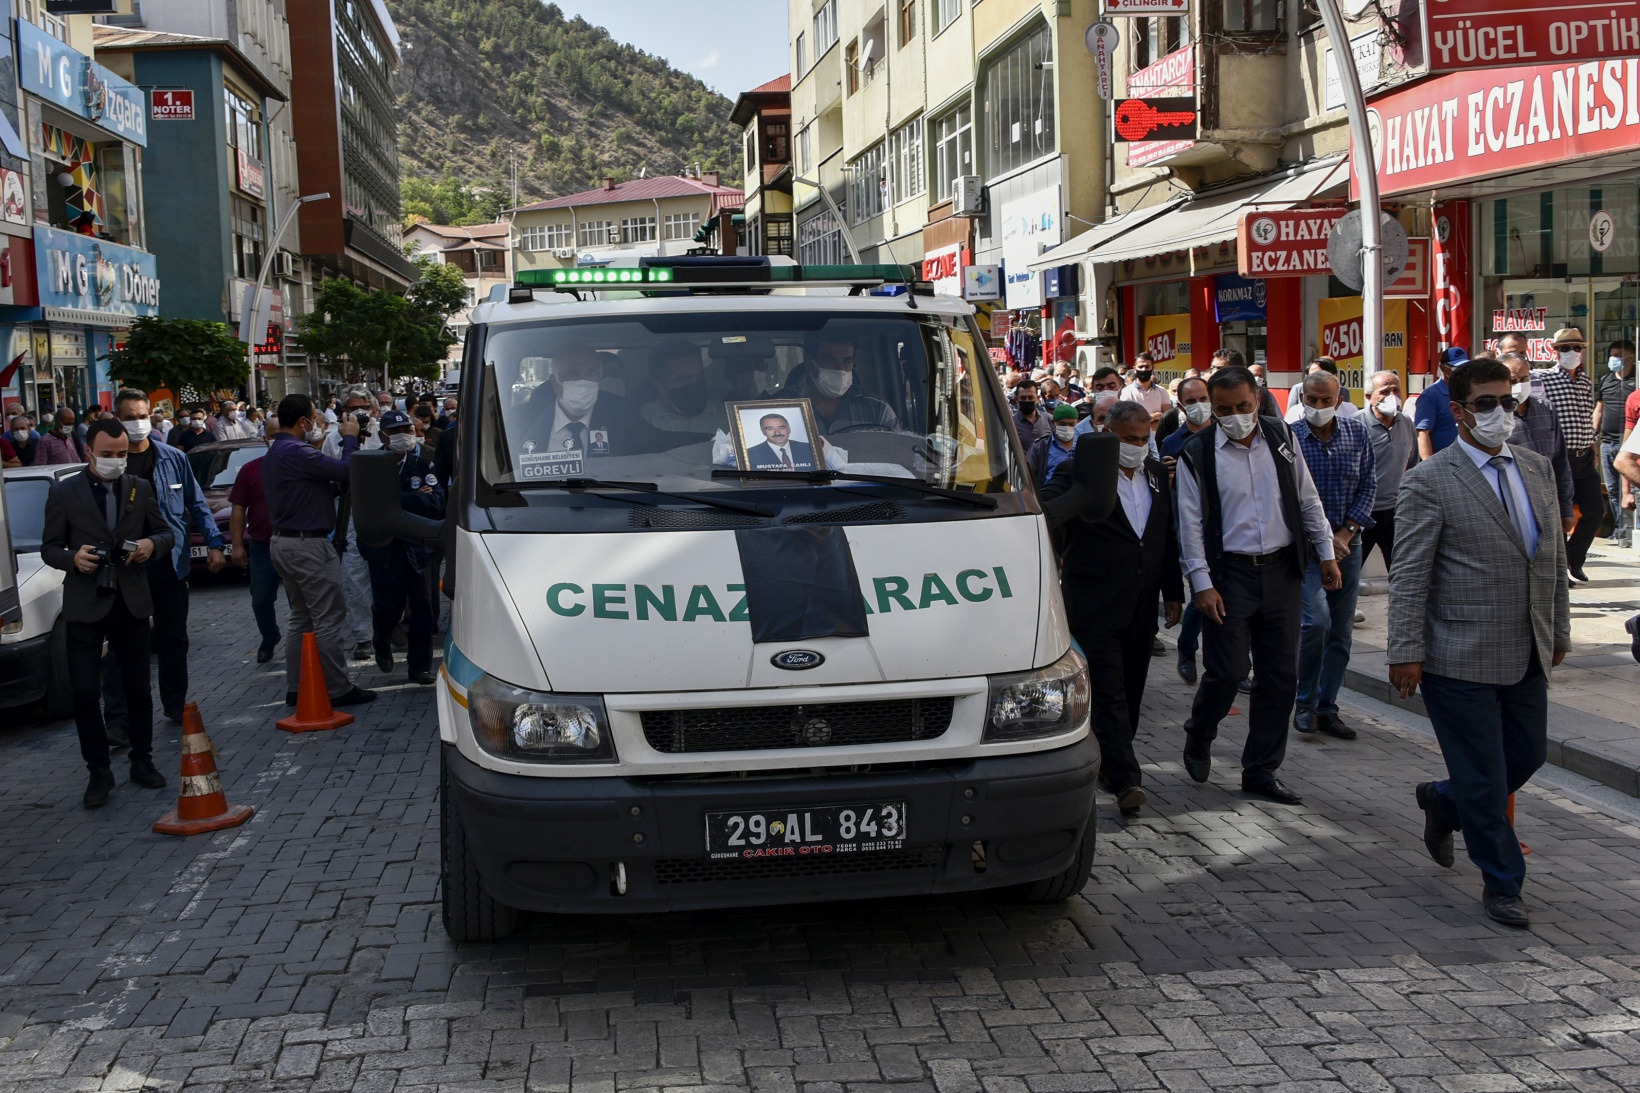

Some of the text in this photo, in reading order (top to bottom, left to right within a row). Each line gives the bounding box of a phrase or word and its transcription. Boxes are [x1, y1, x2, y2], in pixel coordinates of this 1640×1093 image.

[1434, 10, 1640, 63] YÜCEL OPTİK
[1096, 37, 1108, 97] ANAHTARCI
[153, 105, 192, 114] NOTER
[163, 92, 181, 105] 1.
[1386, 97, 1458, 176] HAYAT
[1251, 248, 1332, 272] ECZANE
[121, 261, 160, 306] Döner
[1218, 287, 1253, 303] KORKMAZ
[1493, 307, 1547, 332] HAYAT
[1384, 332, 1403, 348] RAN
[524, 461, 580, 477] GÖREVLİ
[544, 566, 1014, 622] CENAZ RACI
[787, 653, 809, 663] Ford
[727, 805, 899, 846] 29 AL 843
[799, 845, 833, 855] OTO
